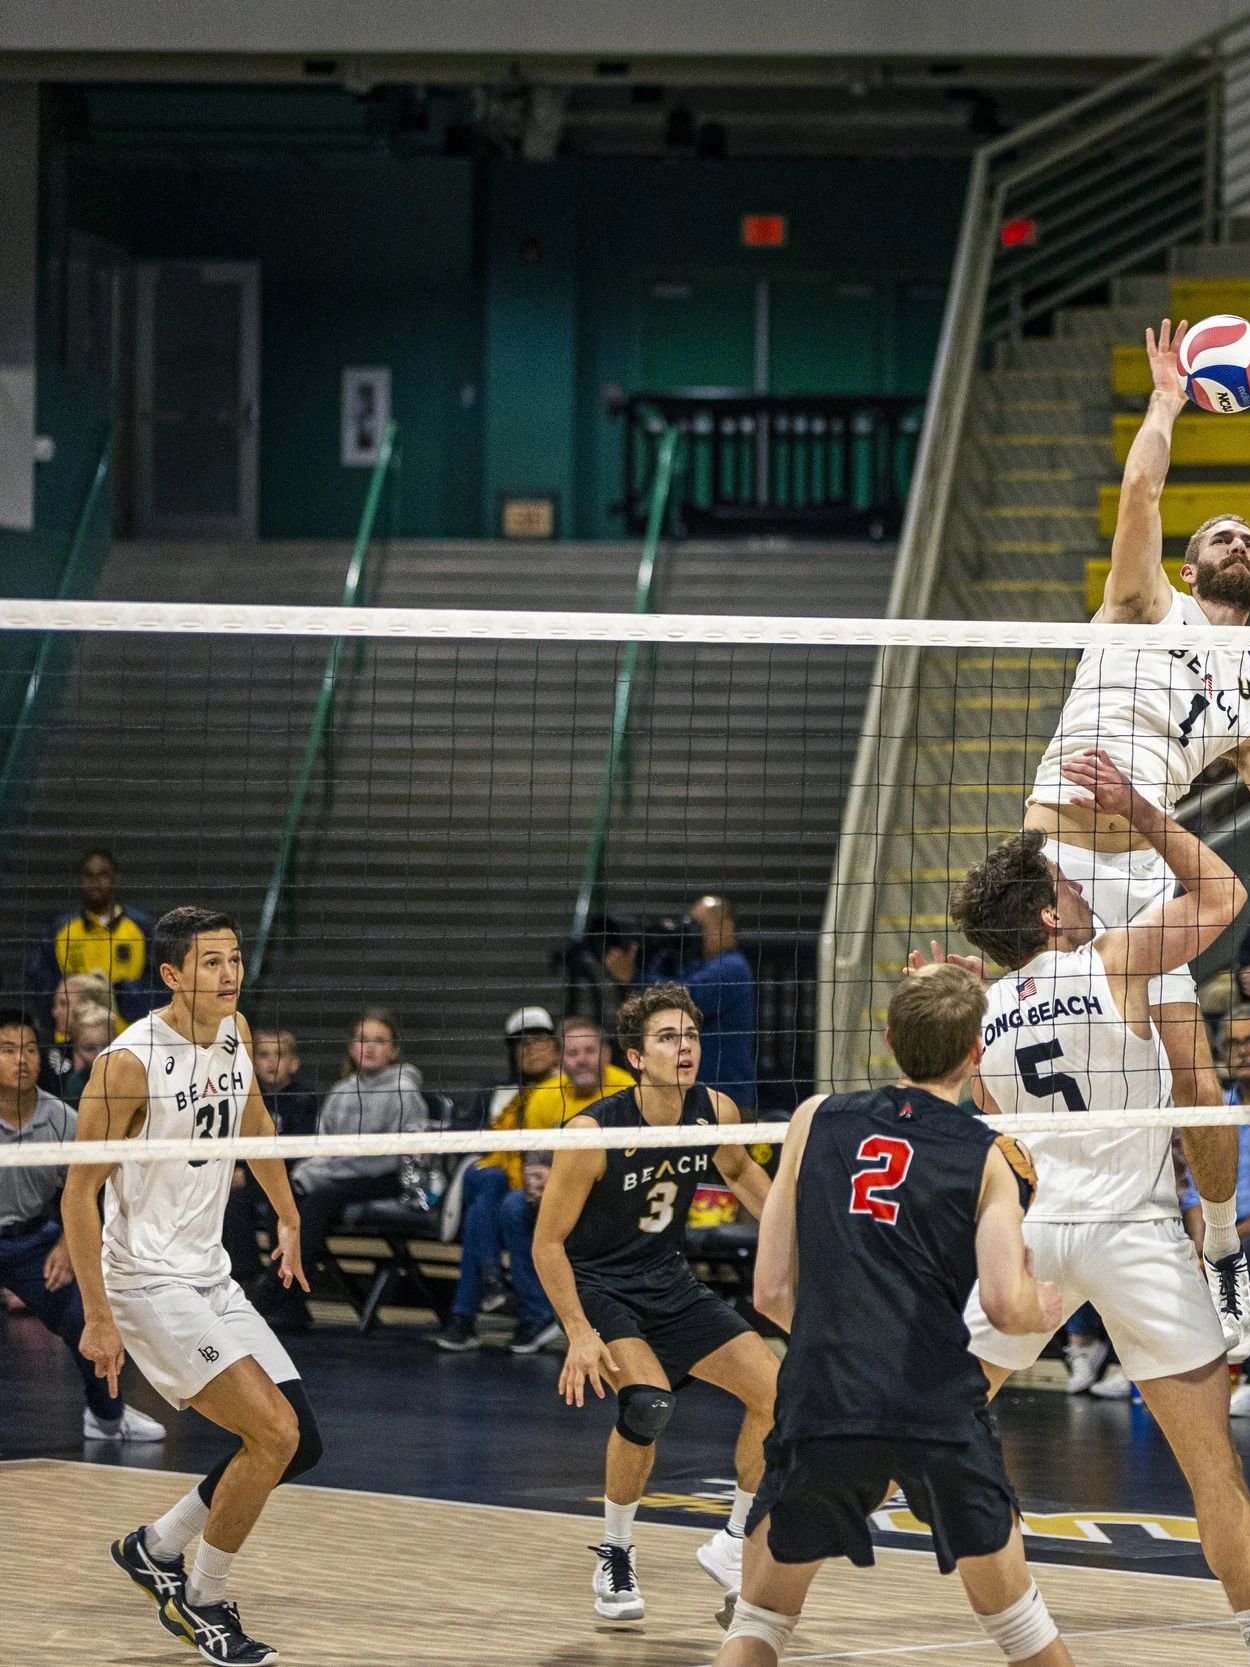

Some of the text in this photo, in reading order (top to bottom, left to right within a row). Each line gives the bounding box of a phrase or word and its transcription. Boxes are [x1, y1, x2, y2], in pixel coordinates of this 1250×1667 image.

[1179, 693, 1211, 748] 1
[981, 996, 1103, 1056] ONG BEACH
[175, 1071, 244, 1112] BEACH
[1015, 1038, 1089, 1112] 5
[623, 1154, 708, 1192] BEACH
[849, 1133, 915, 1226] 2
[638, 1181, 679, 1234] 3
